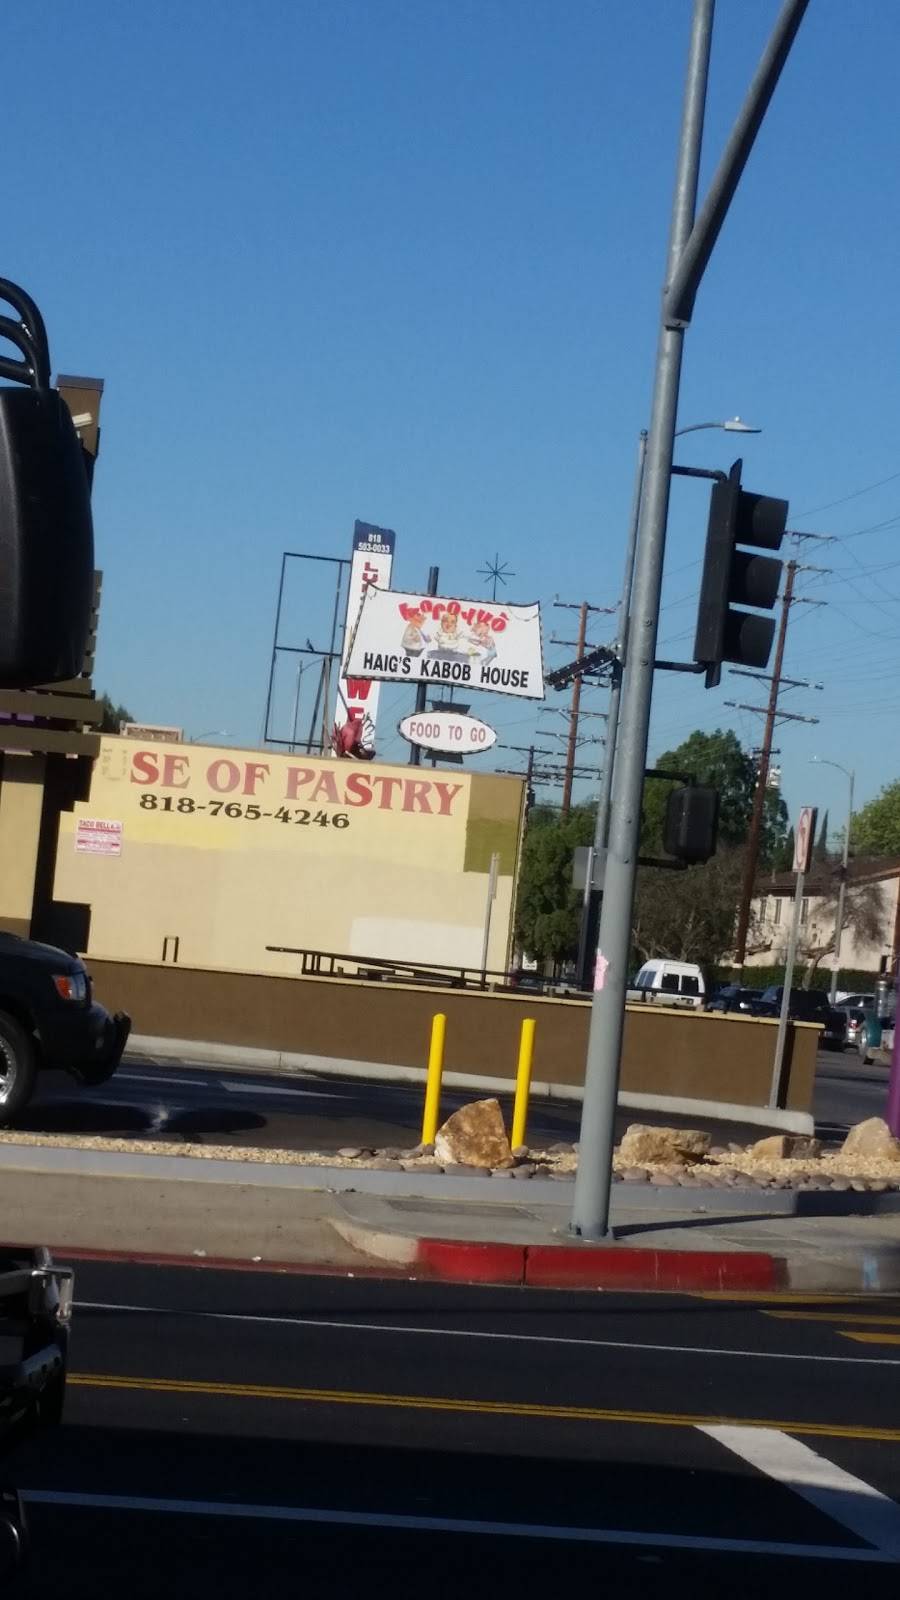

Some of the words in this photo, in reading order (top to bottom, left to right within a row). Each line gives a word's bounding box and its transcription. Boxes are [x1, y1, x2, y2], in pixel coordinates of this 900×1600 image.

[368, 533, 382, 543] 818
[363, 652, 411, 675] HAIG'S
[420, 659, 471, 681] KABOB
[480, 667, 529, 688] HOUSE
[409, 721, 441, 739] FOOD
[448, 725, 463, 741] TO
[470, 728, 486, 743] GO
[206, 759, 270, 796] OF
[285, 767, 464, 816] PASTRY
[140, 793, 350, 830] 818-765-4246
